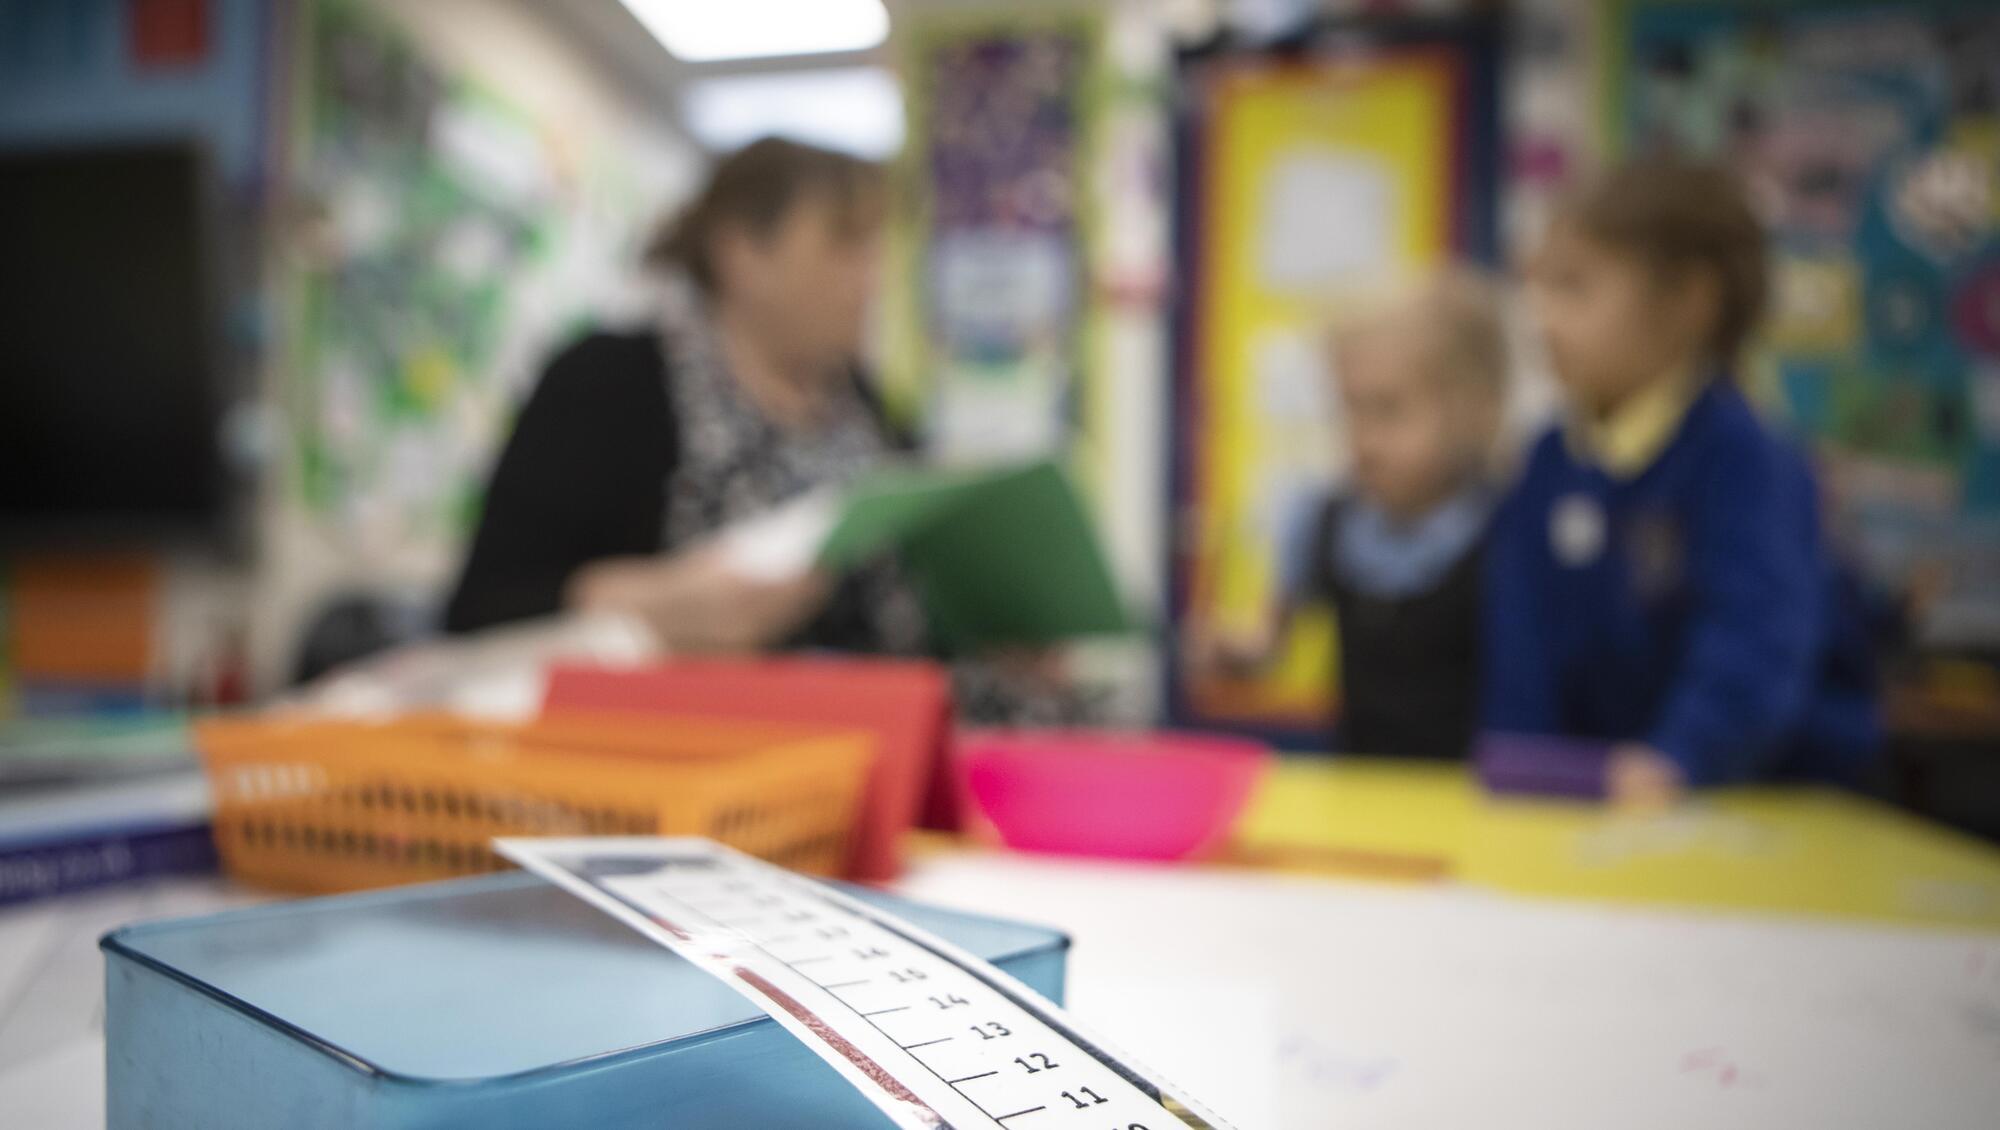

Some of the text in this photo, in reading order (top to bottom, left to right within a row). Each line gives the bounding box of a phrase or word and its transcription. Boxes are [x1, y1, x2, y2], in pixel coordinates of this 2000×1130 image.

[889, 968, 928, 984] 15
[928, 993, 971, 1011] 14
[969, 1021, 1013, 1041] 13
[1013, 1052, 1060, 1075] 12
[1060, 1085, 1109, 1110] 11
